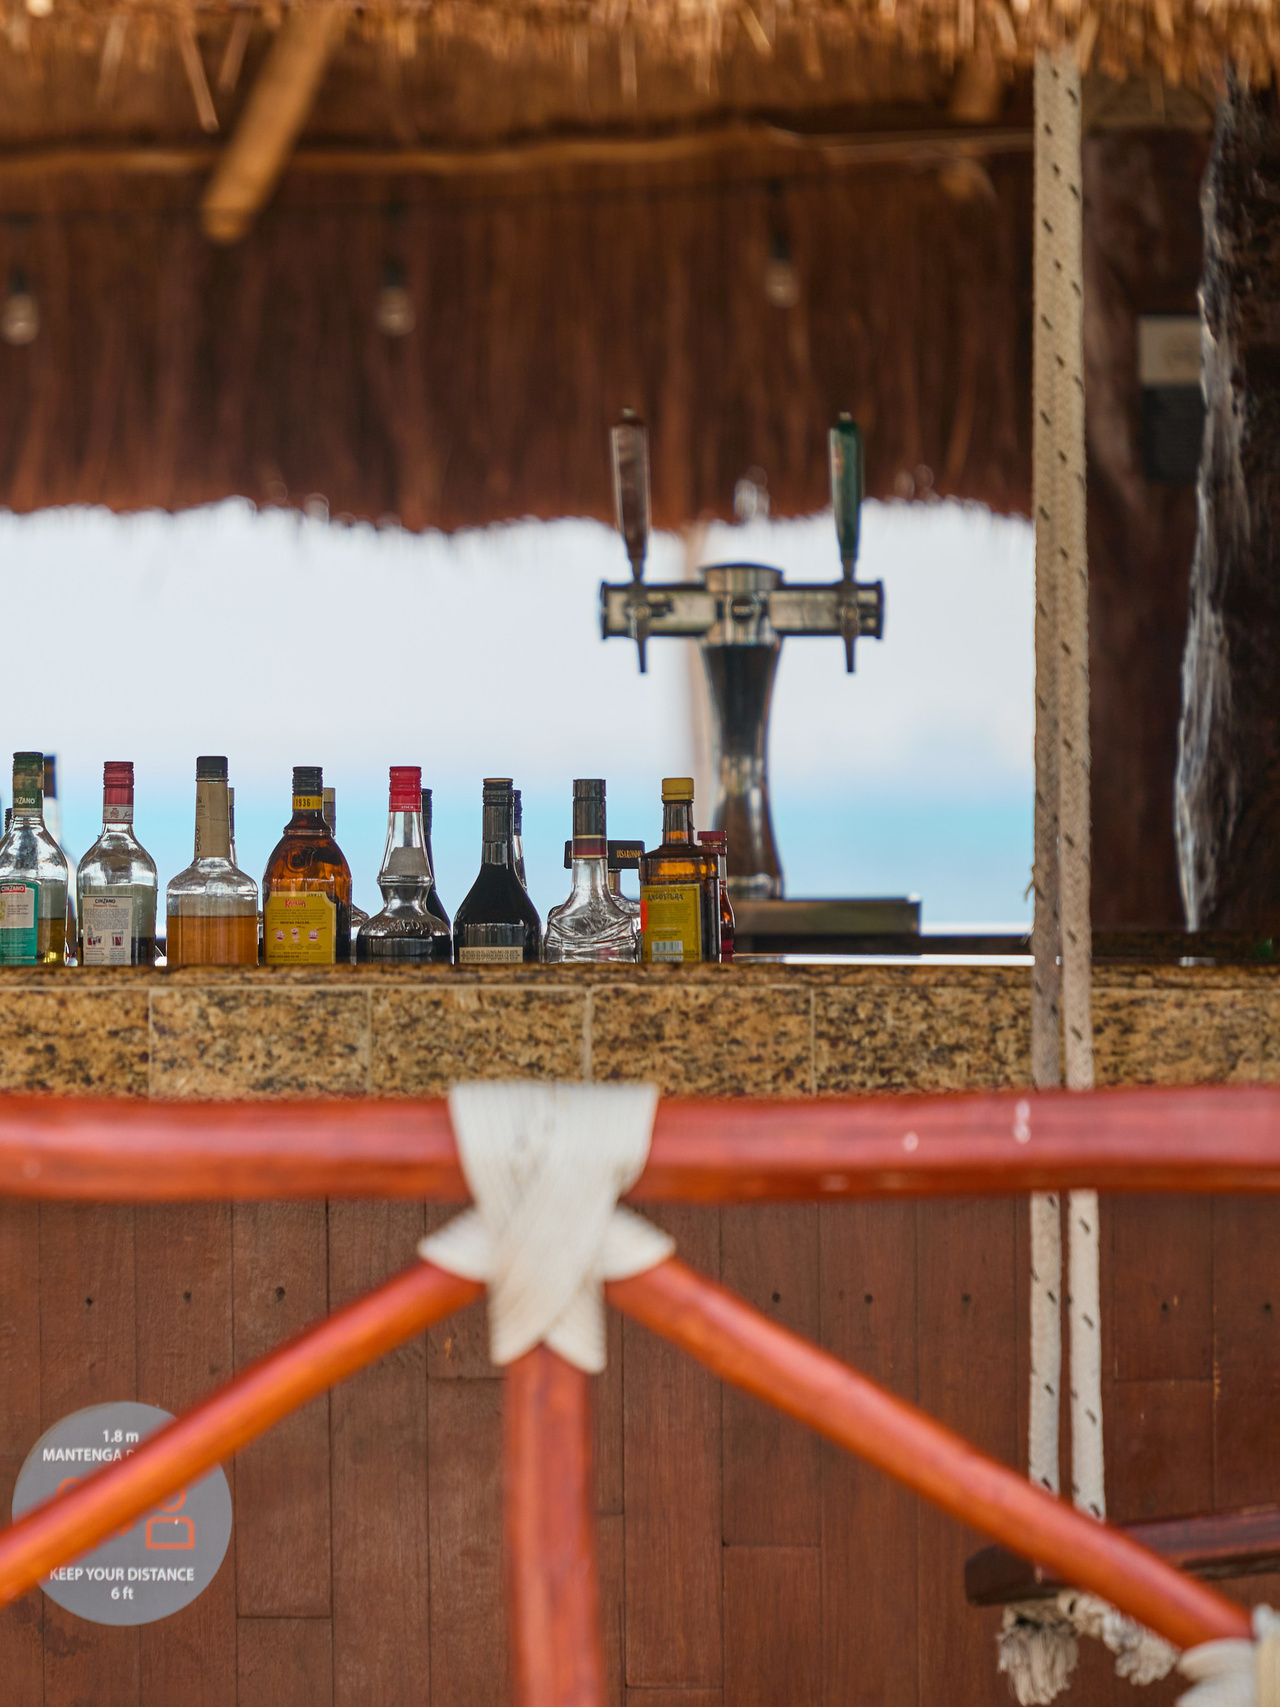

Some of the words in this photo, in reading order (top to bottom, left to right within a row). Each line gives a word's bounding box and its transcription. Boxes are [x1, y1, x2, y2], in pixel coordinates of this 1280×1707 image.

[296, 799, 311, 807] 1936
[648, 892, 684, 902] ANGOSTURA
[103, 1429, 123, 1443] 1.8
[125, 1431, 139, 1443] m
[42, 1447, 122, 1462] MANTENGA
[49, 1567, 83, 1581] KEEP
[86, 1567, 124, 1581] YOUR
[127, 1567, 195, 1581] DISTANCE
[110, 1586, 120, 1600] 6
[122, 1586, 134, 1600] ft
